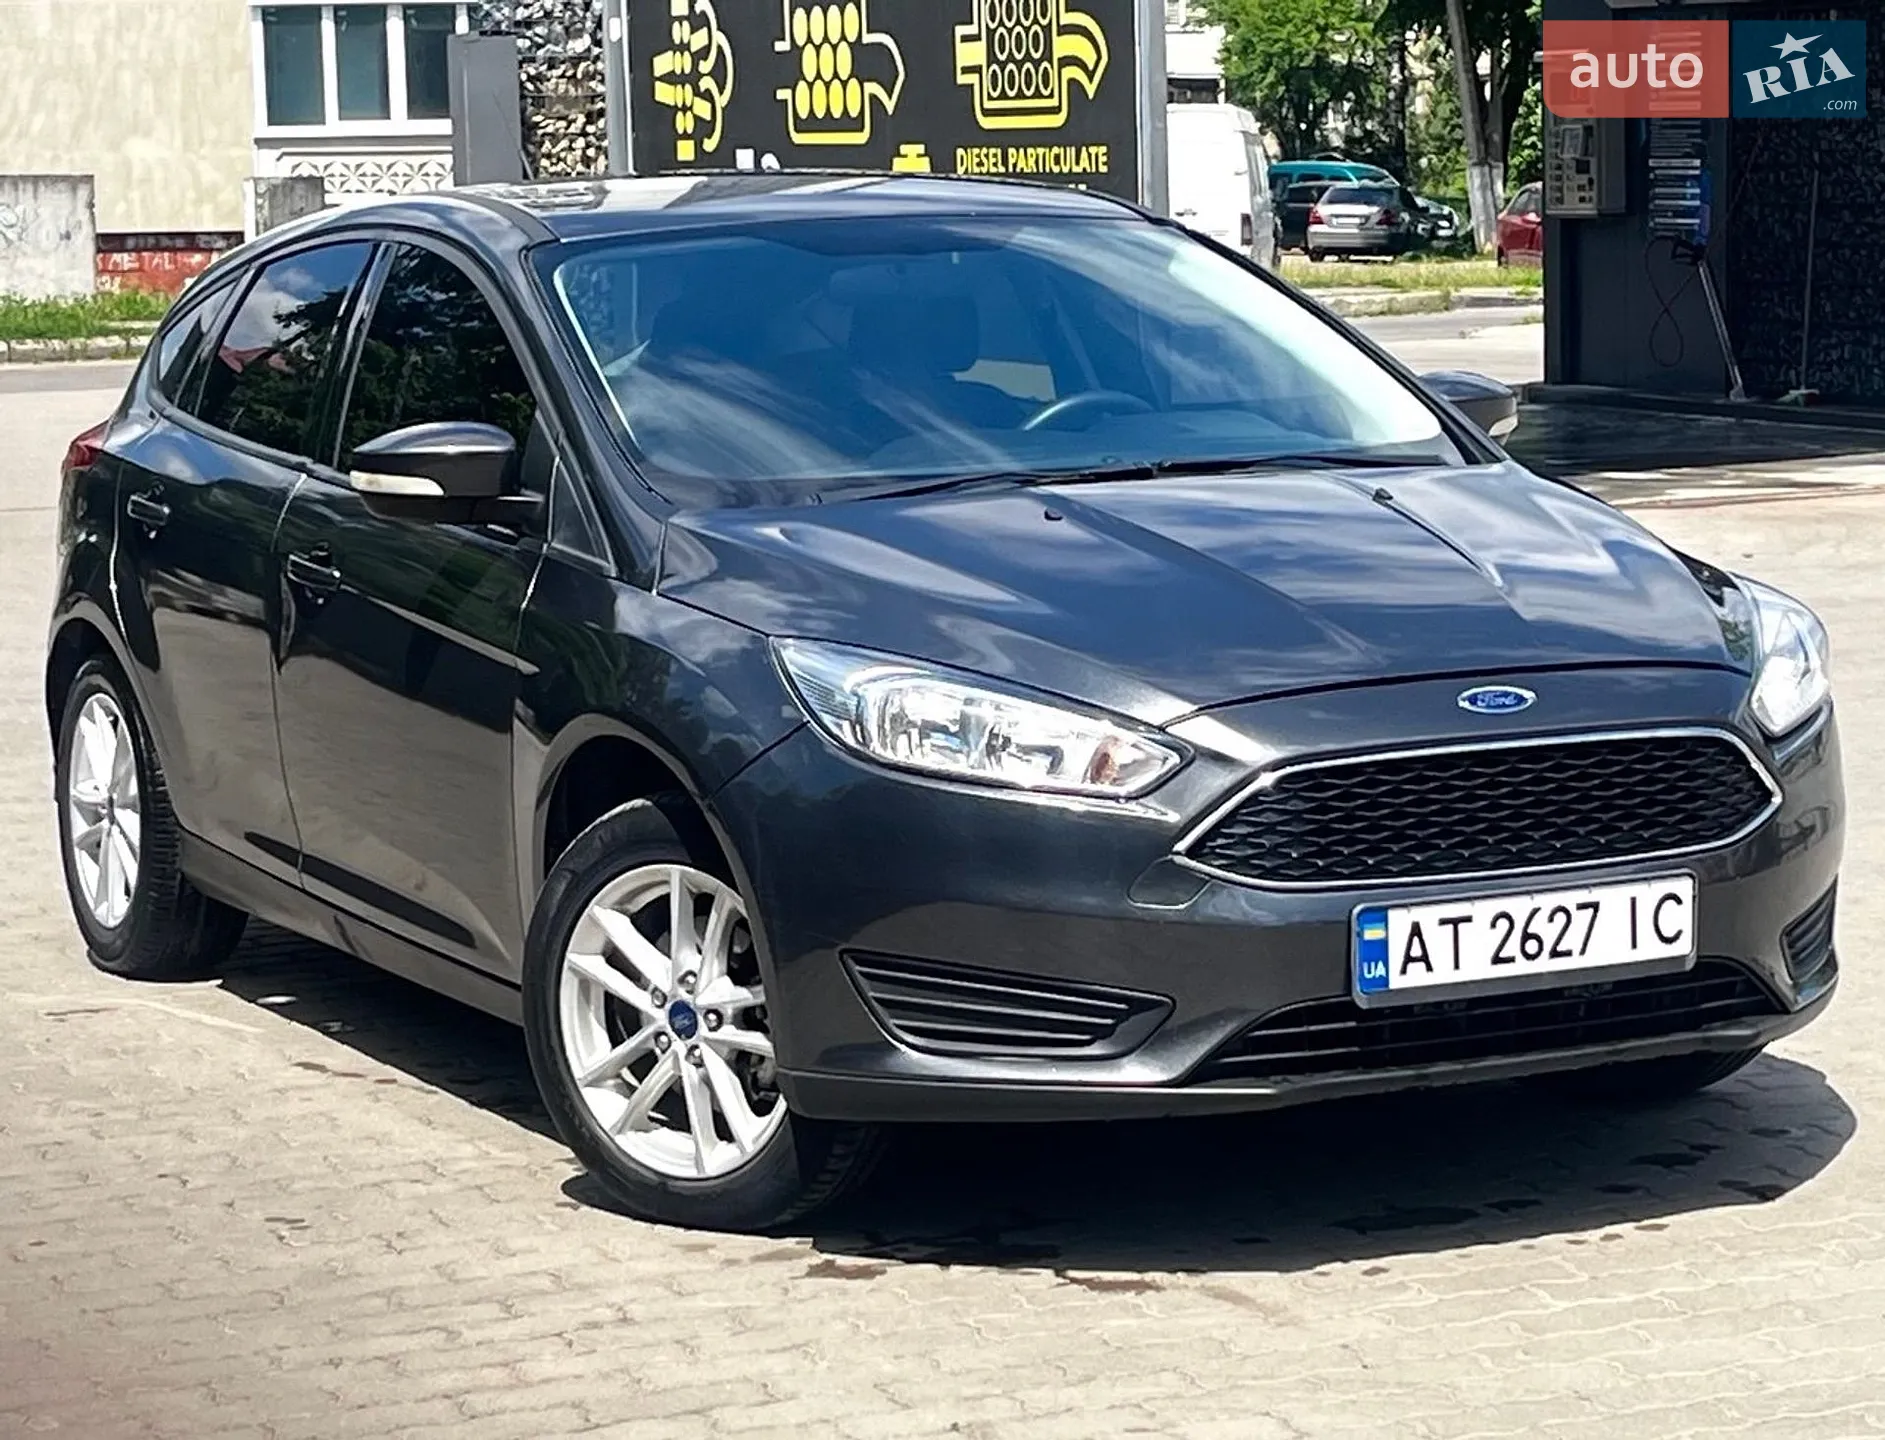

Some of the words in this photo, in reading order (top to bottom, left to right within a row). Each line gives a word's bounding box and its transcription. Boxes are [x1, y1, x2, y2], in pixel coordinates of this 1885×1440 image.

[956, 147, 1006, 175] DIESEL
[1008, 145, 1109, 173] PARTICULATE
[1472, 691, 1519, 707] Ford
[1399, 915, 1474, 976] AT
[1489, 901, 1600, 966] 2627
[1629, 892, 1684, 950] IC
[1362, 962, 1387, 979] UA
